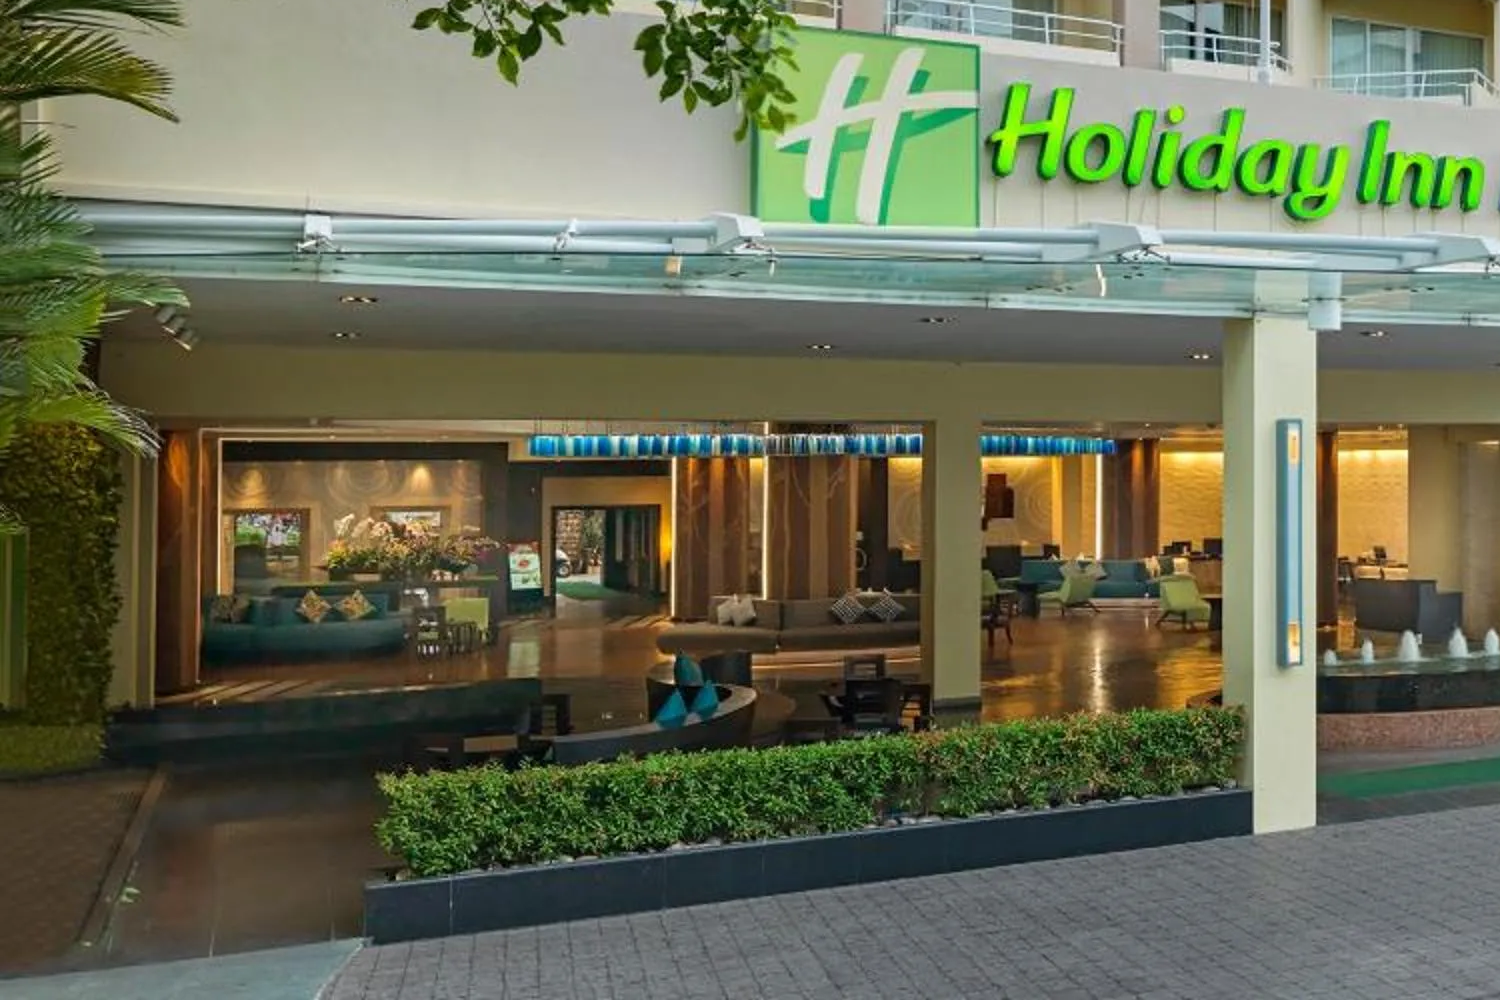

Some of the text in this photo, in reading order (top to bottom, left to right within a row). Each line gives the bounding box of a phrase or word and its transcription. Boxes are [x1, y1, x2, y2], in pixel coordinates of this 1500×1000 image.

[775, 46, 977, 225] H
[986, 82, 1351, 222] Holiday
[1355, 119, 1486, 213] Inn
